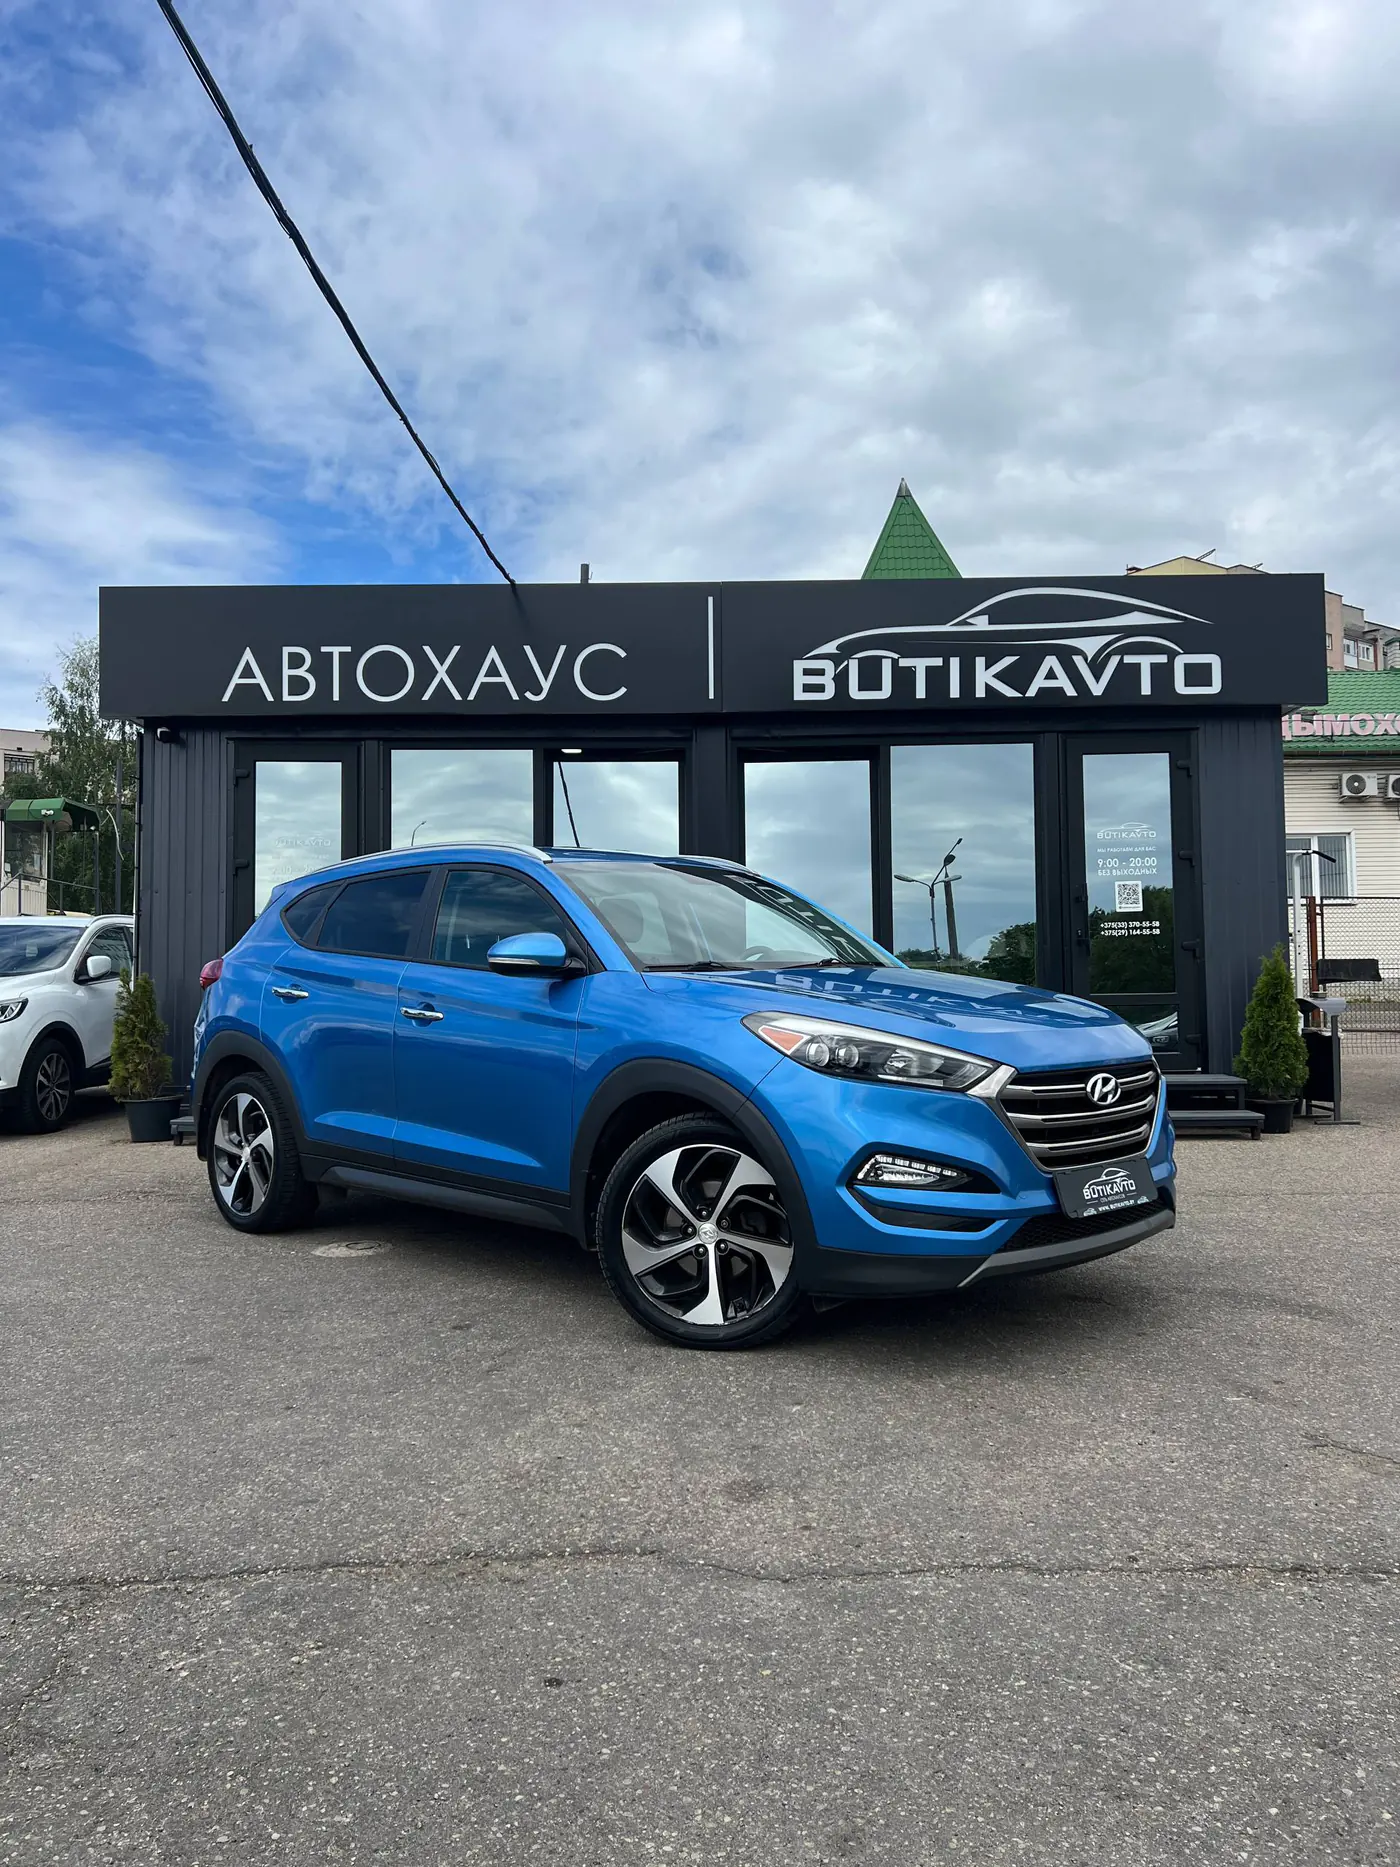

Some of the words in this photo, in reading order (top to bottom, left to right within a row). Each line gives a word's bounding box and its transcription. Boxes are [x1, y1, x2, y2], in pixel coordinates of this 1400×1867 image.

[221, 643, 628, 702] АВТОХАУС
[793, 653, 1222, 701] BUTIKAVTO
[1281, 712, 1400, 741] ЫМОХ
[1097, 830, 1157, 839] BUTIKAVTO
[1097, 858, 1119, 868] 9:00
[1129, 857, 1157, 867] 20:00
[1112, 868, 1158, 876] ВЫХОДНЫХ
[1100, 921, 1128, 929] +375(33)
[1082, 1179, 1136, 1200] BUTIKAVTO
